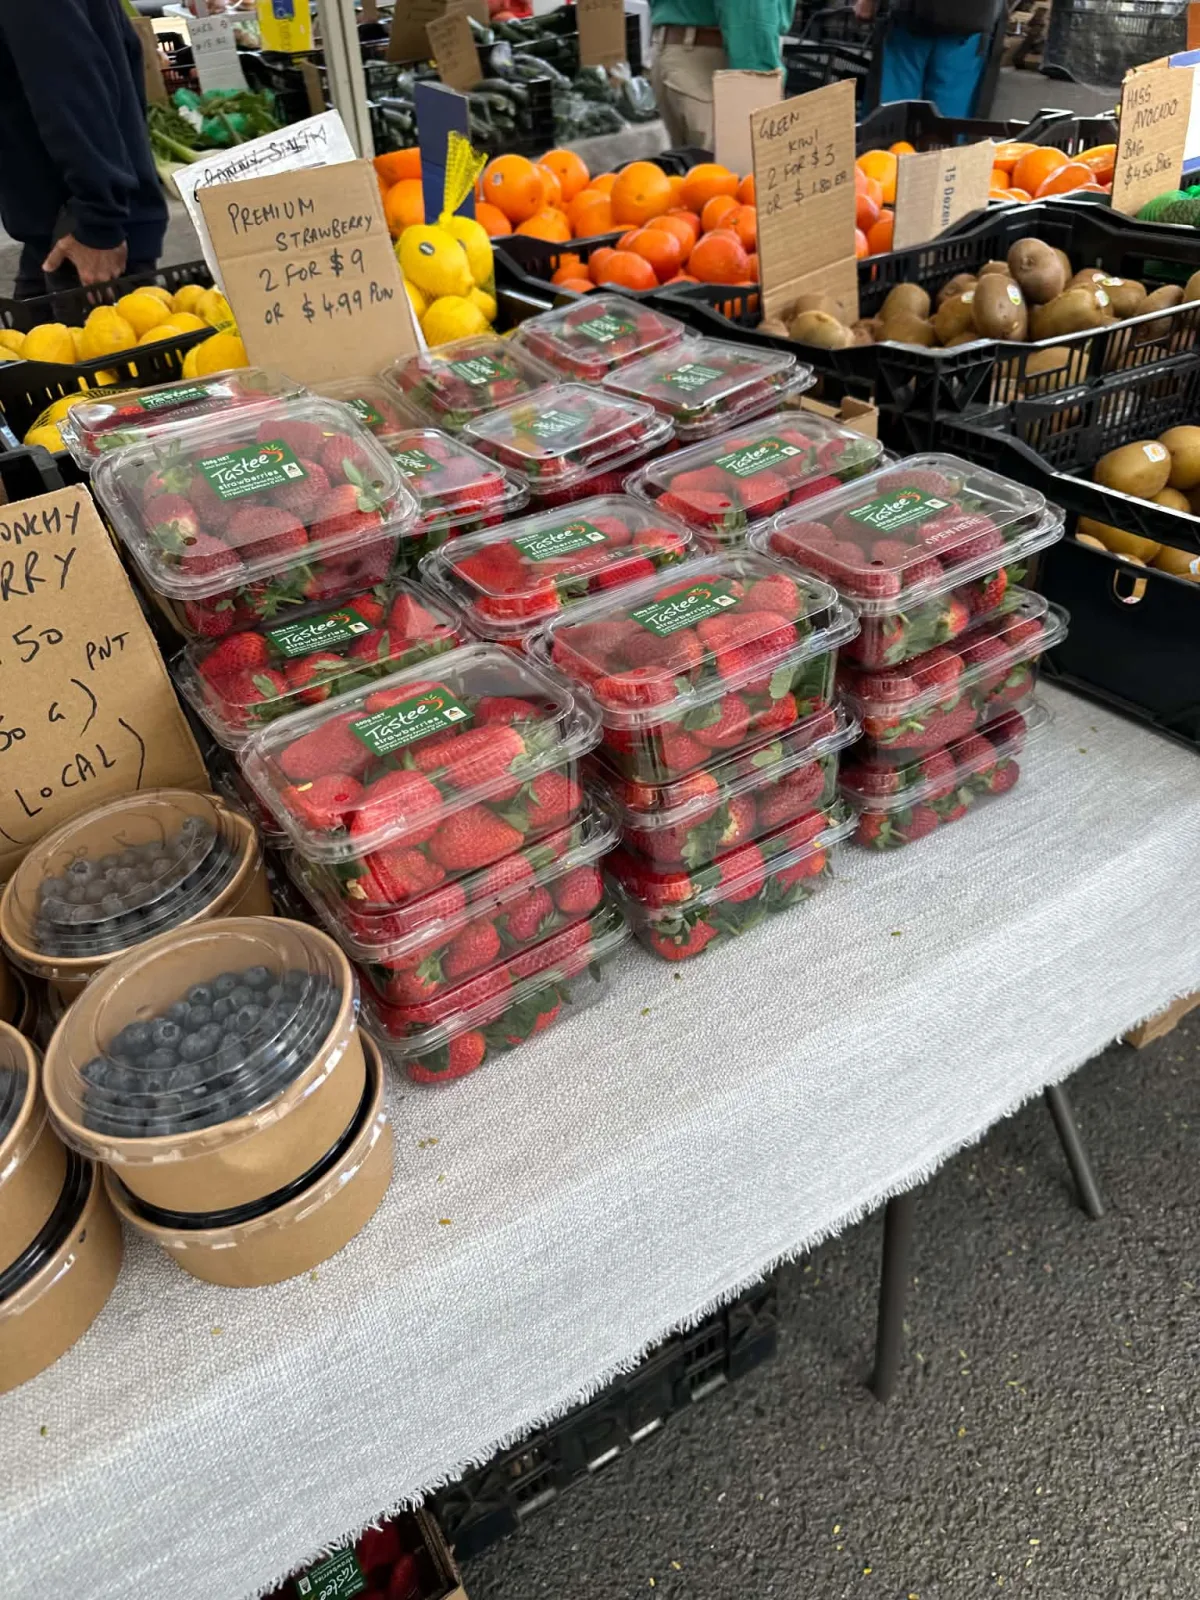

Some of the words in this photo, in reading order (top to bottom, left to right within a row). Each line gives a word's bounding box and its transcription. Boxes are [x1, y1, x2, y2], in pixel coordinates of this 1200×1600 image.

[759, 111, 799, 140] GREEN
[768, 168, 777, 191] 2
[784, 155, 805, 182] FOR
[944, 166, 956, 182] 15
[228, 197, 315, 235] PREMIUM
[766, 194, 782, 215] OR
[942, 187, 955, 227] Dozen
[275, 215, 373, 252] STRAWBERRY
[259, 268, 279, 293] 2
[285, 261, 322, 287] FOR
[265, 301, 284, 325] OR
[210, 453, 270, 484] Tastee
[218, 469, 279, 491] strawberries
[523, 530, 574, 552] Tastee
[644, 595, 699, 626] Tastee
[279, 619, 337, 646] Tastee
[86, 631, 130, 671] PNT
[364, 704, 429, 740] Tastee
[374, 716, 440, 747] strawberries
